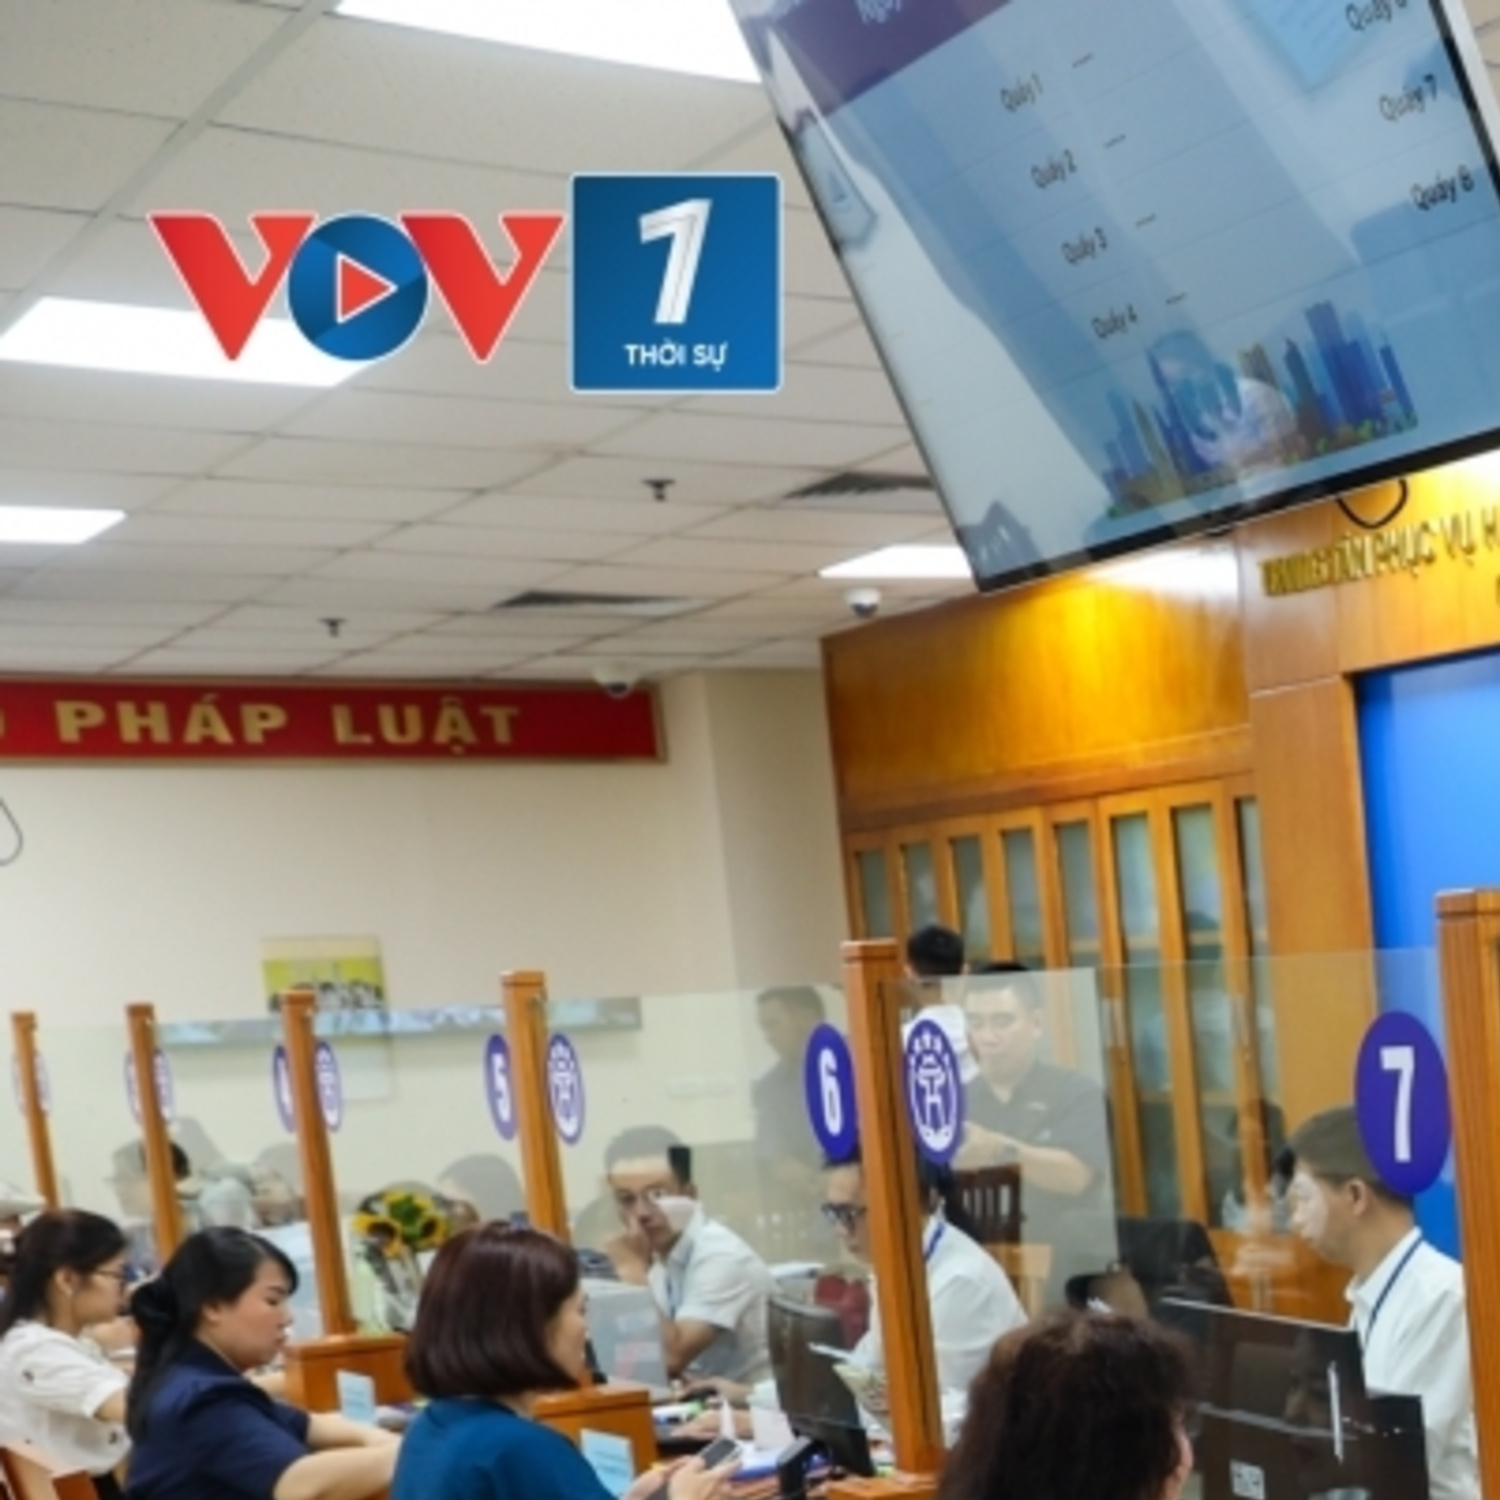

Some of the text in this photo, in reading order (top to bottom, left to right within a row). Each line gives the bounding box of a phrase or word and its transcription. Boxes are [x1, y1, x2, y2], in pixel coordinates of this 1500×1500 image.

[1424, 73, 1438, 99] 7
[1063, 149, 1077, 174] 2
[55, 694, 288, 743] PHÁP
[331, 696, 520, 754] LUẬT
[491, 1052, 512, 1122] 5
[818, 1047, 844, 1136] 6
[1380, 1046, 1415, 1162] 7
